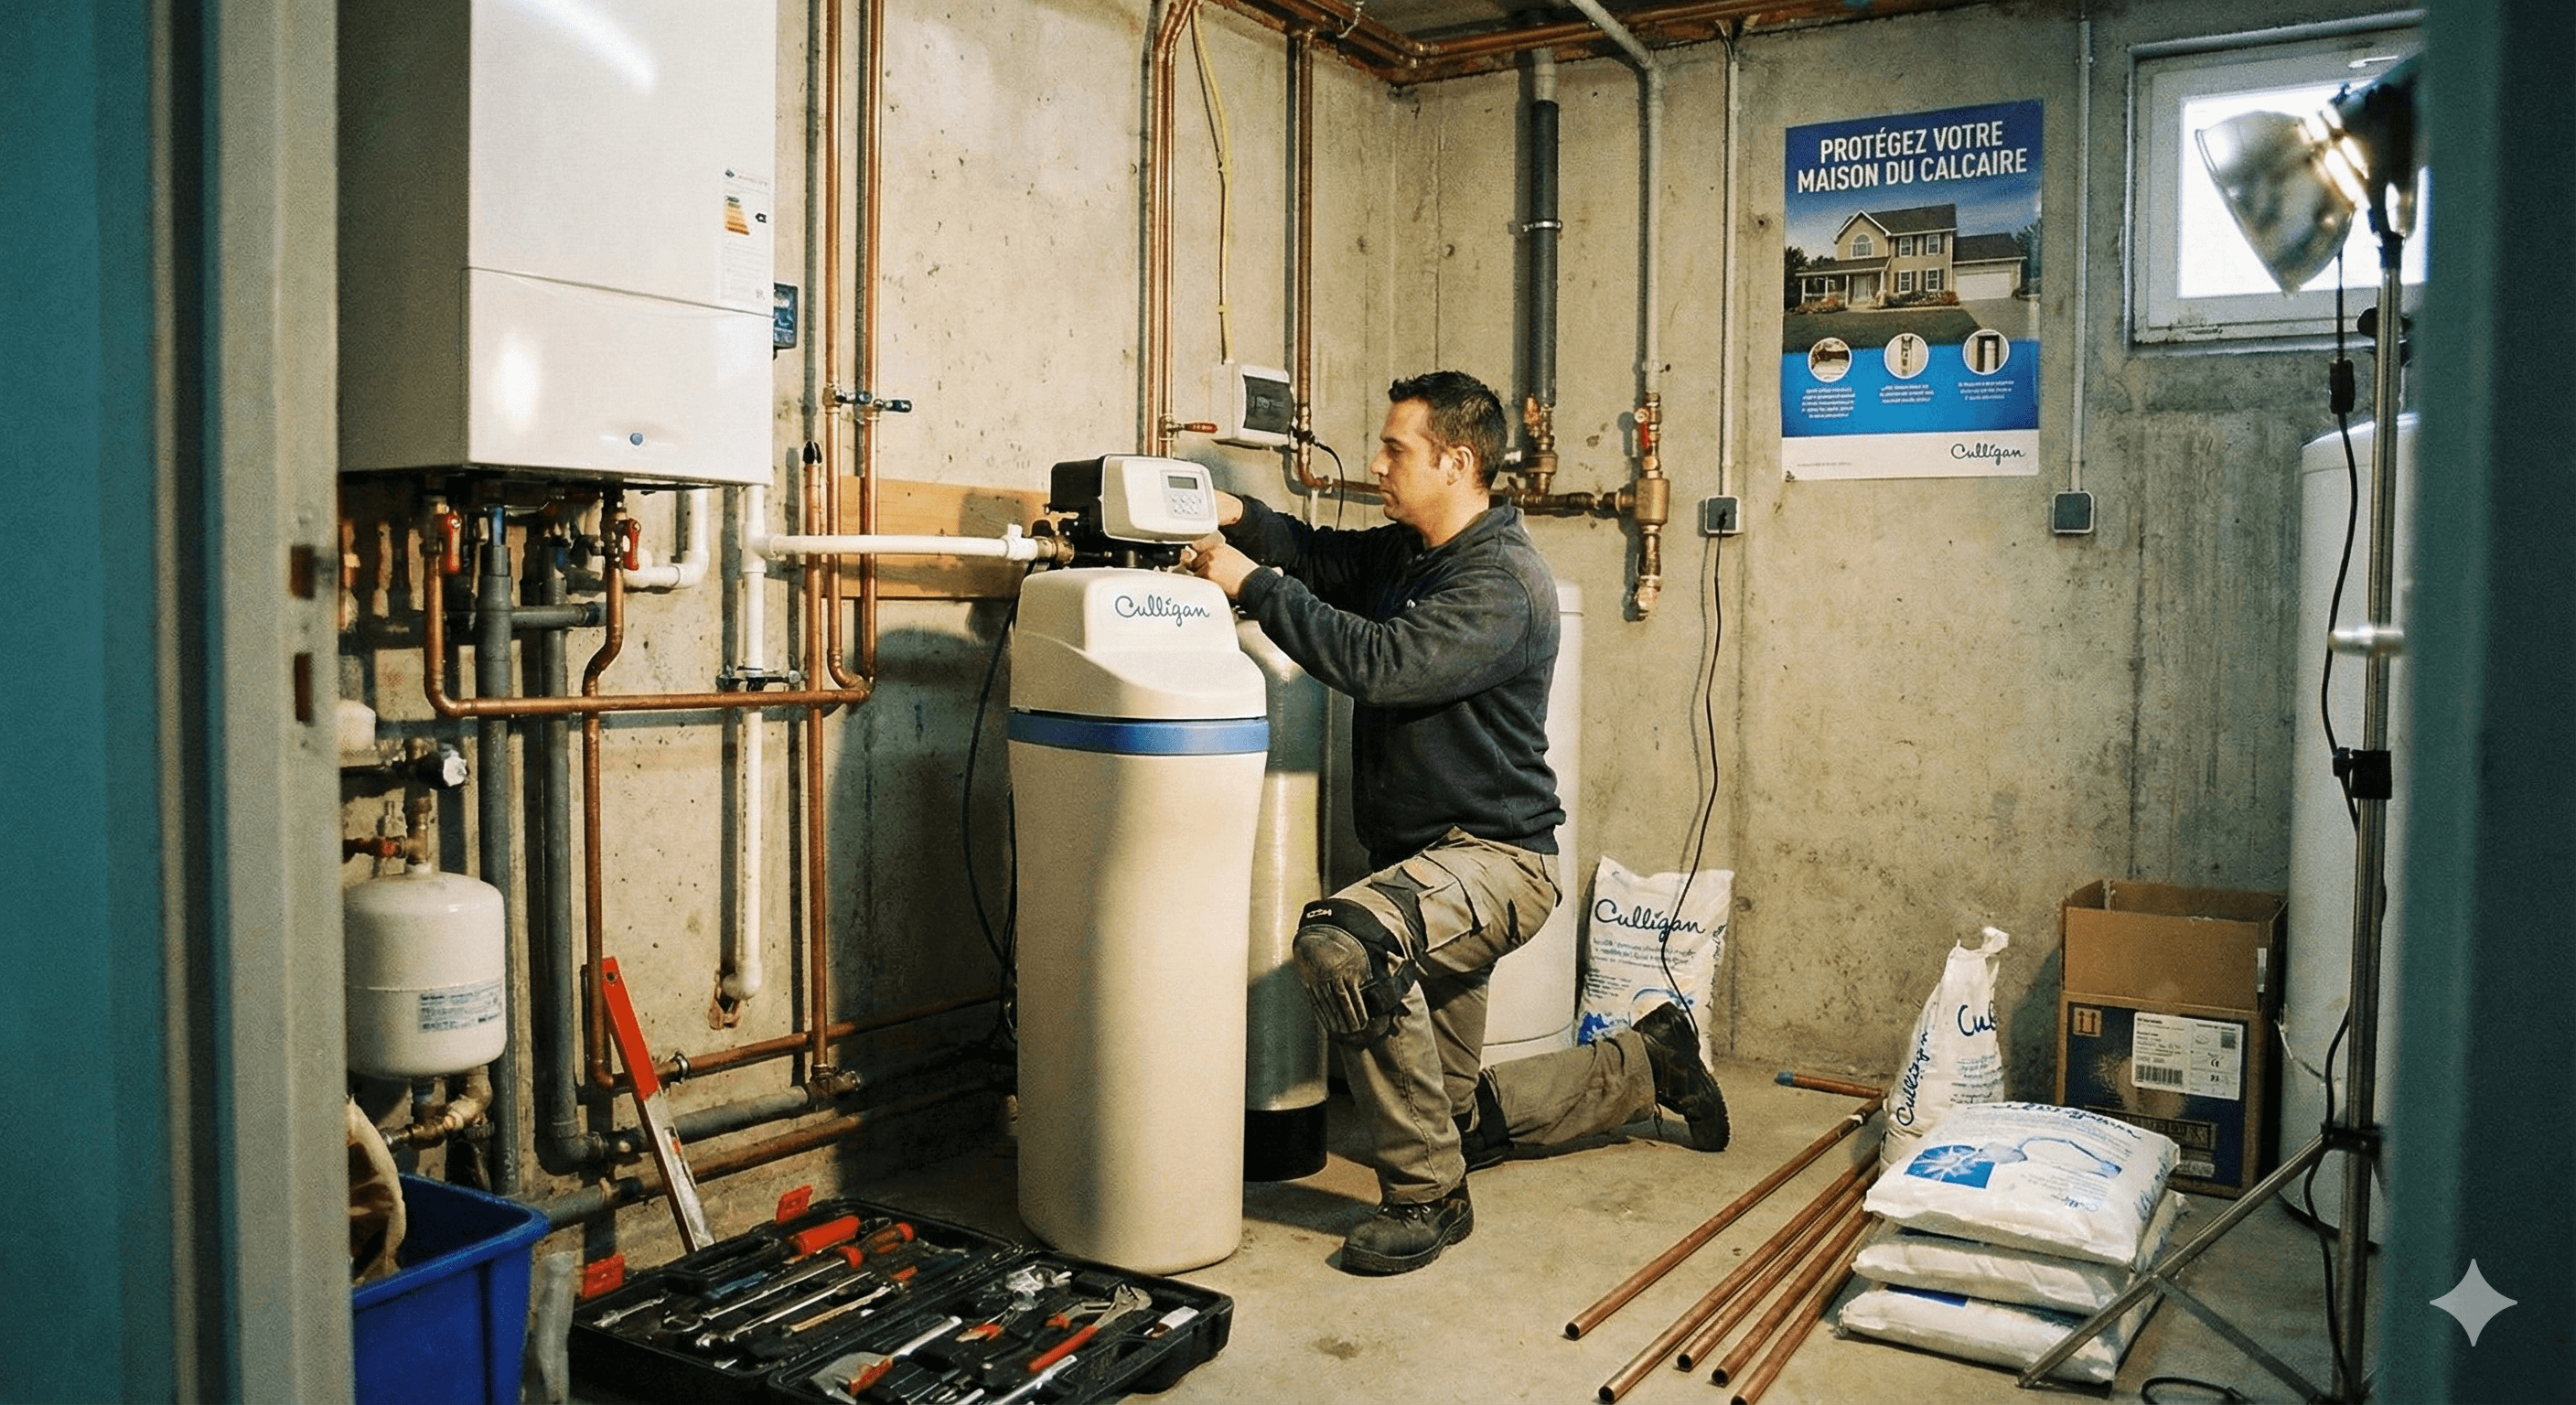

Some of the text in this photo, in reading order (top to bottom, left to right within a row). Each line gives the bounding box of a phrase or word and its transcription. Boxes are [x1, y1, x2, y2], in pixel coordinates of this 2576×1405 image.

[1820, 120, 2003, 164] PROTÉGEZ VOTRE
[1797, 147, 2028, 193] MAISON DU CALCAIRE
[1950, 443, 2026, 467] Culligan
[1115, 595, 1210, 627] Culligan
[1594, 898, 1705, 942] Culligan
